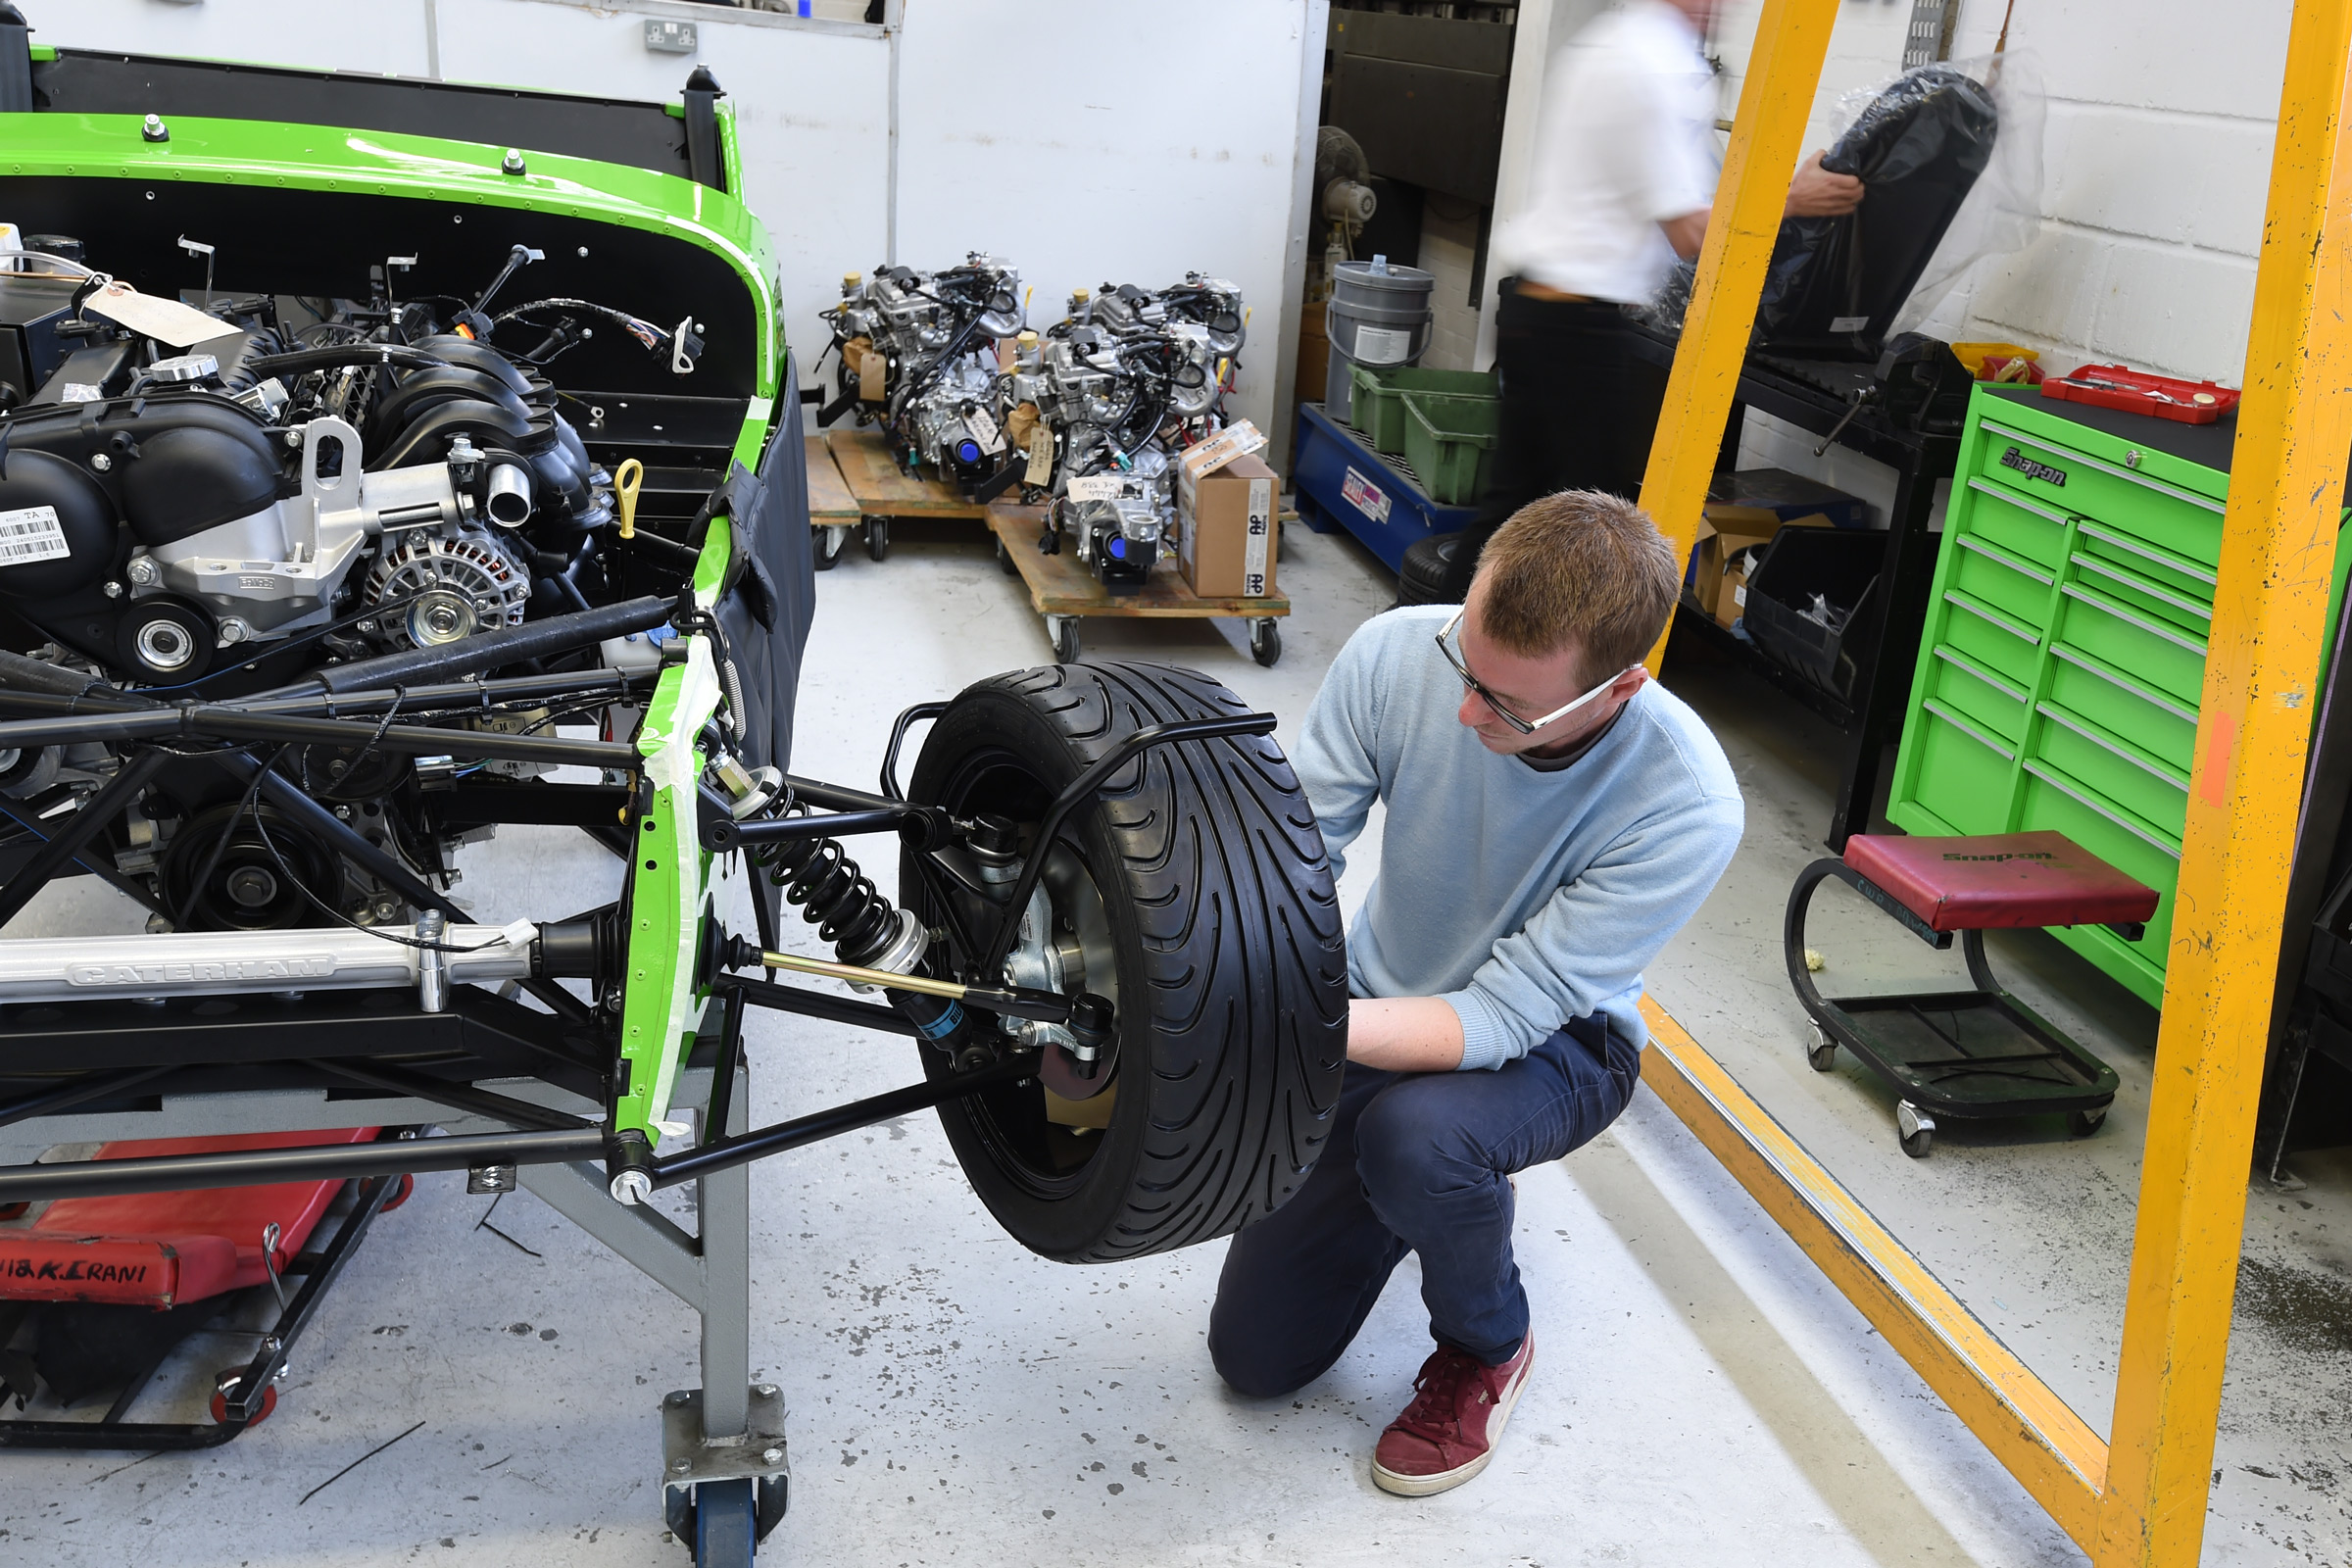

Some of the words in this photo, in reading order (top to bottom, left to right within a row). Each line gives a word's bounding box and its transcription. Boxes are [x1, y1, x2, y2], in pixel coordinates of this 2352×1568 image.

[1999, 447, 2067, 487] Snap-on
[24, 511, 40, 519] TA
[1942, 853, 2053, 862] Snap-on
[73, 958, 329, 985] CATERHAM
